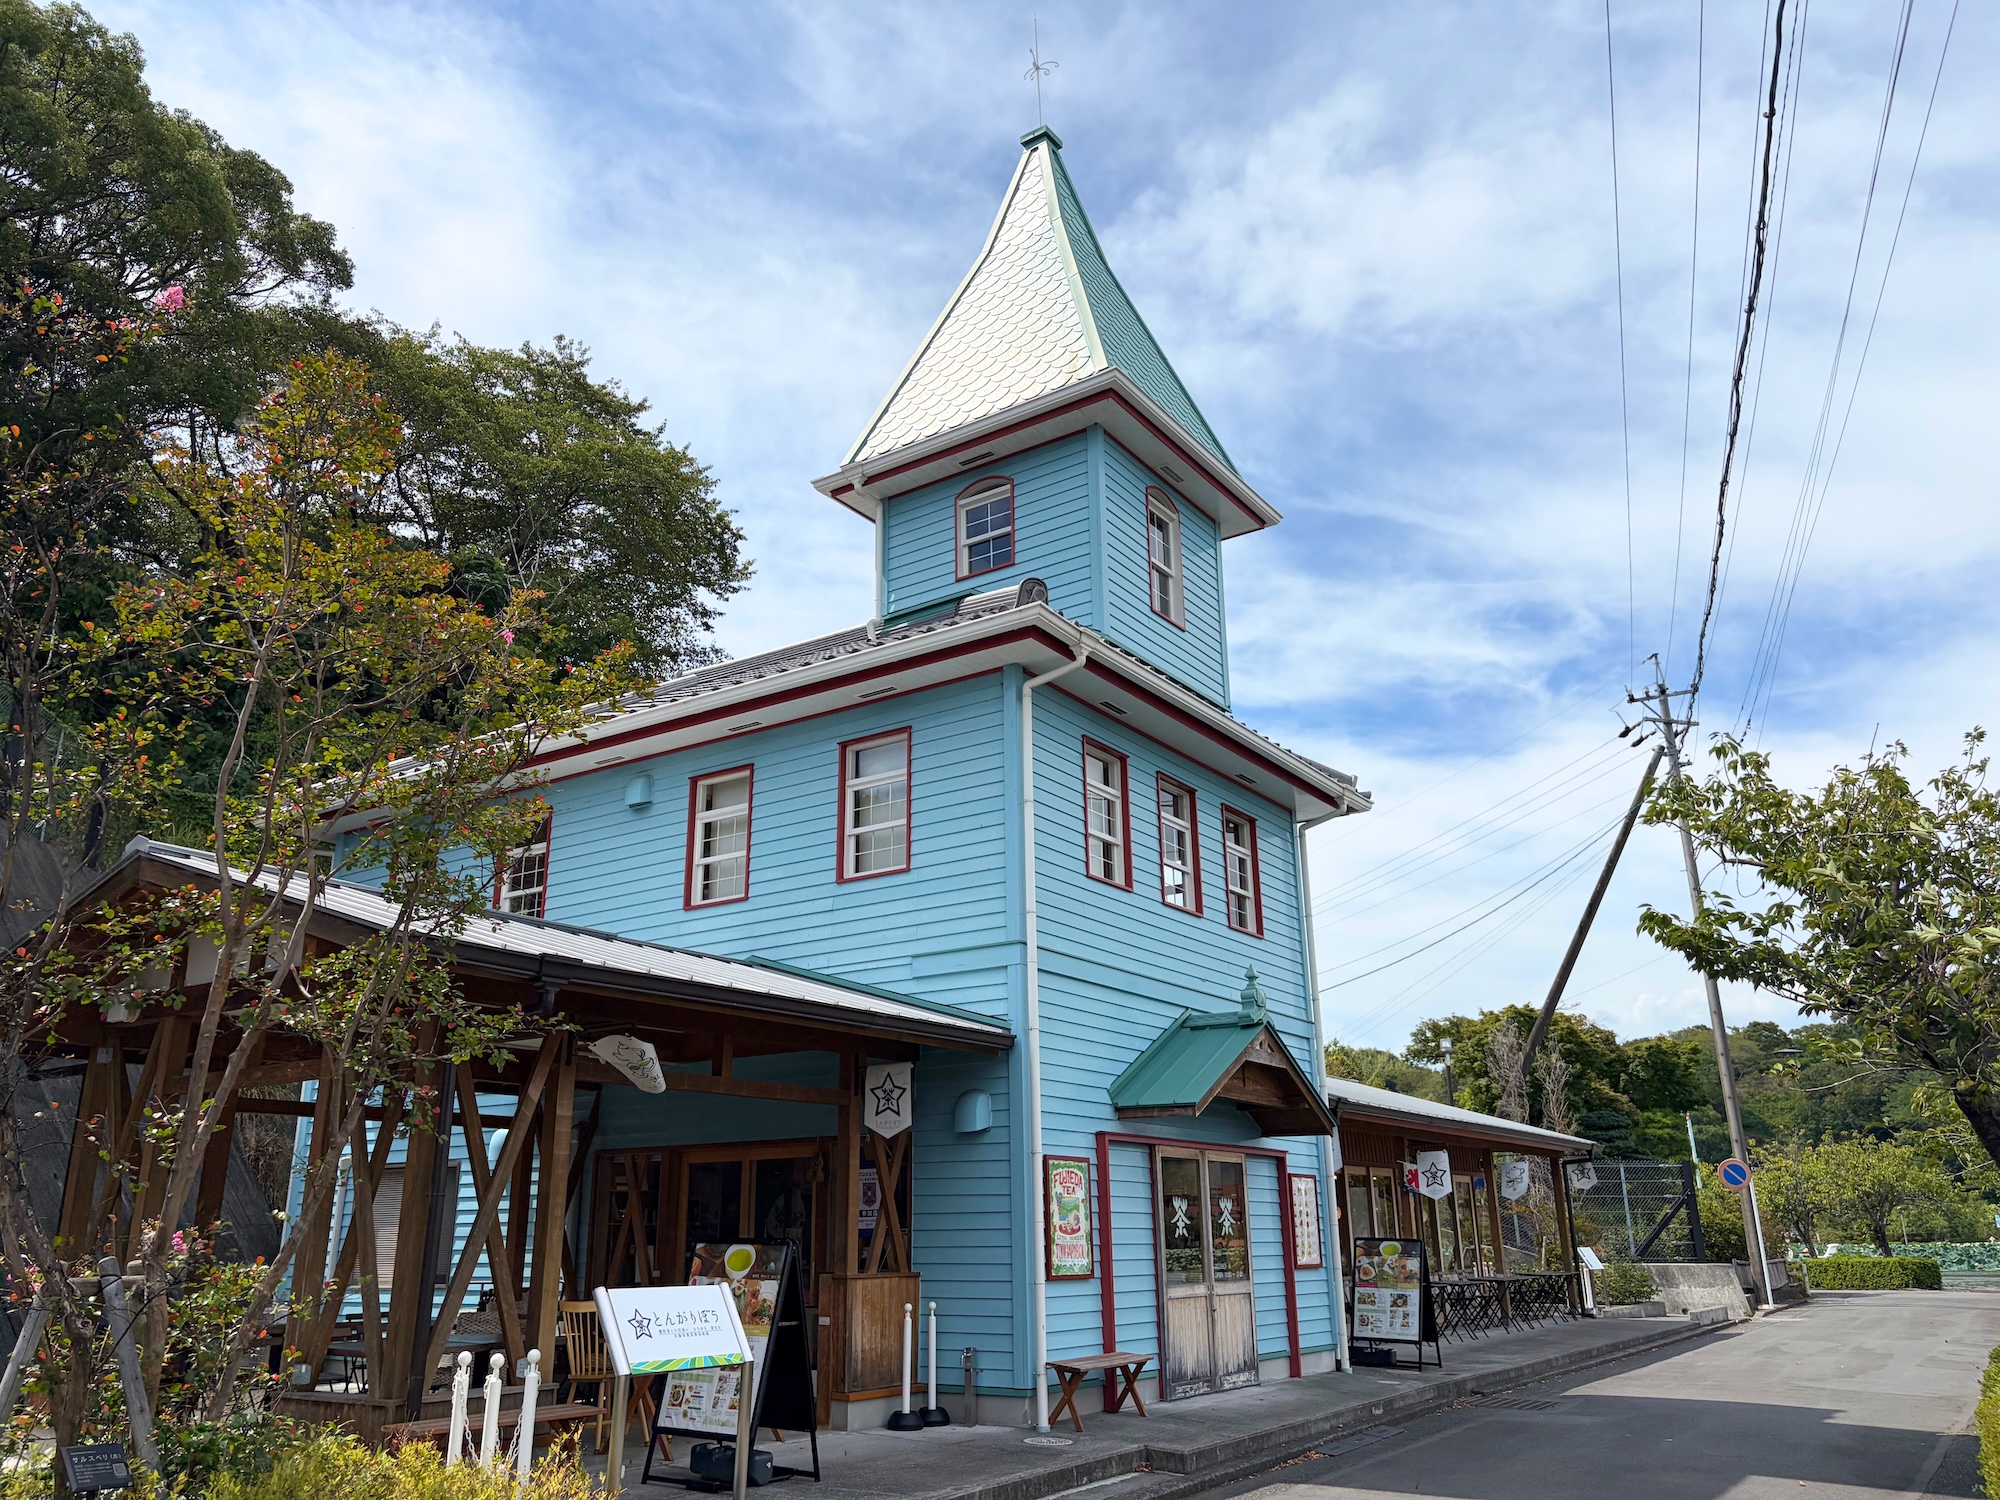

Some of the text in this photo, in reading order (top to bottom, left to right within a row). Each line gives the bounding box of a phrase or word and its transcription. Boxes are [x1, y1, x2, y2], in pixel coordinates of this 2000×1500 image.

[1053, 1170, 1083, 1191] FUJIEDA
[1062, 1185, 1076, 1195] TEA
[653, 1309, 719, 1327] とんがりぼう
